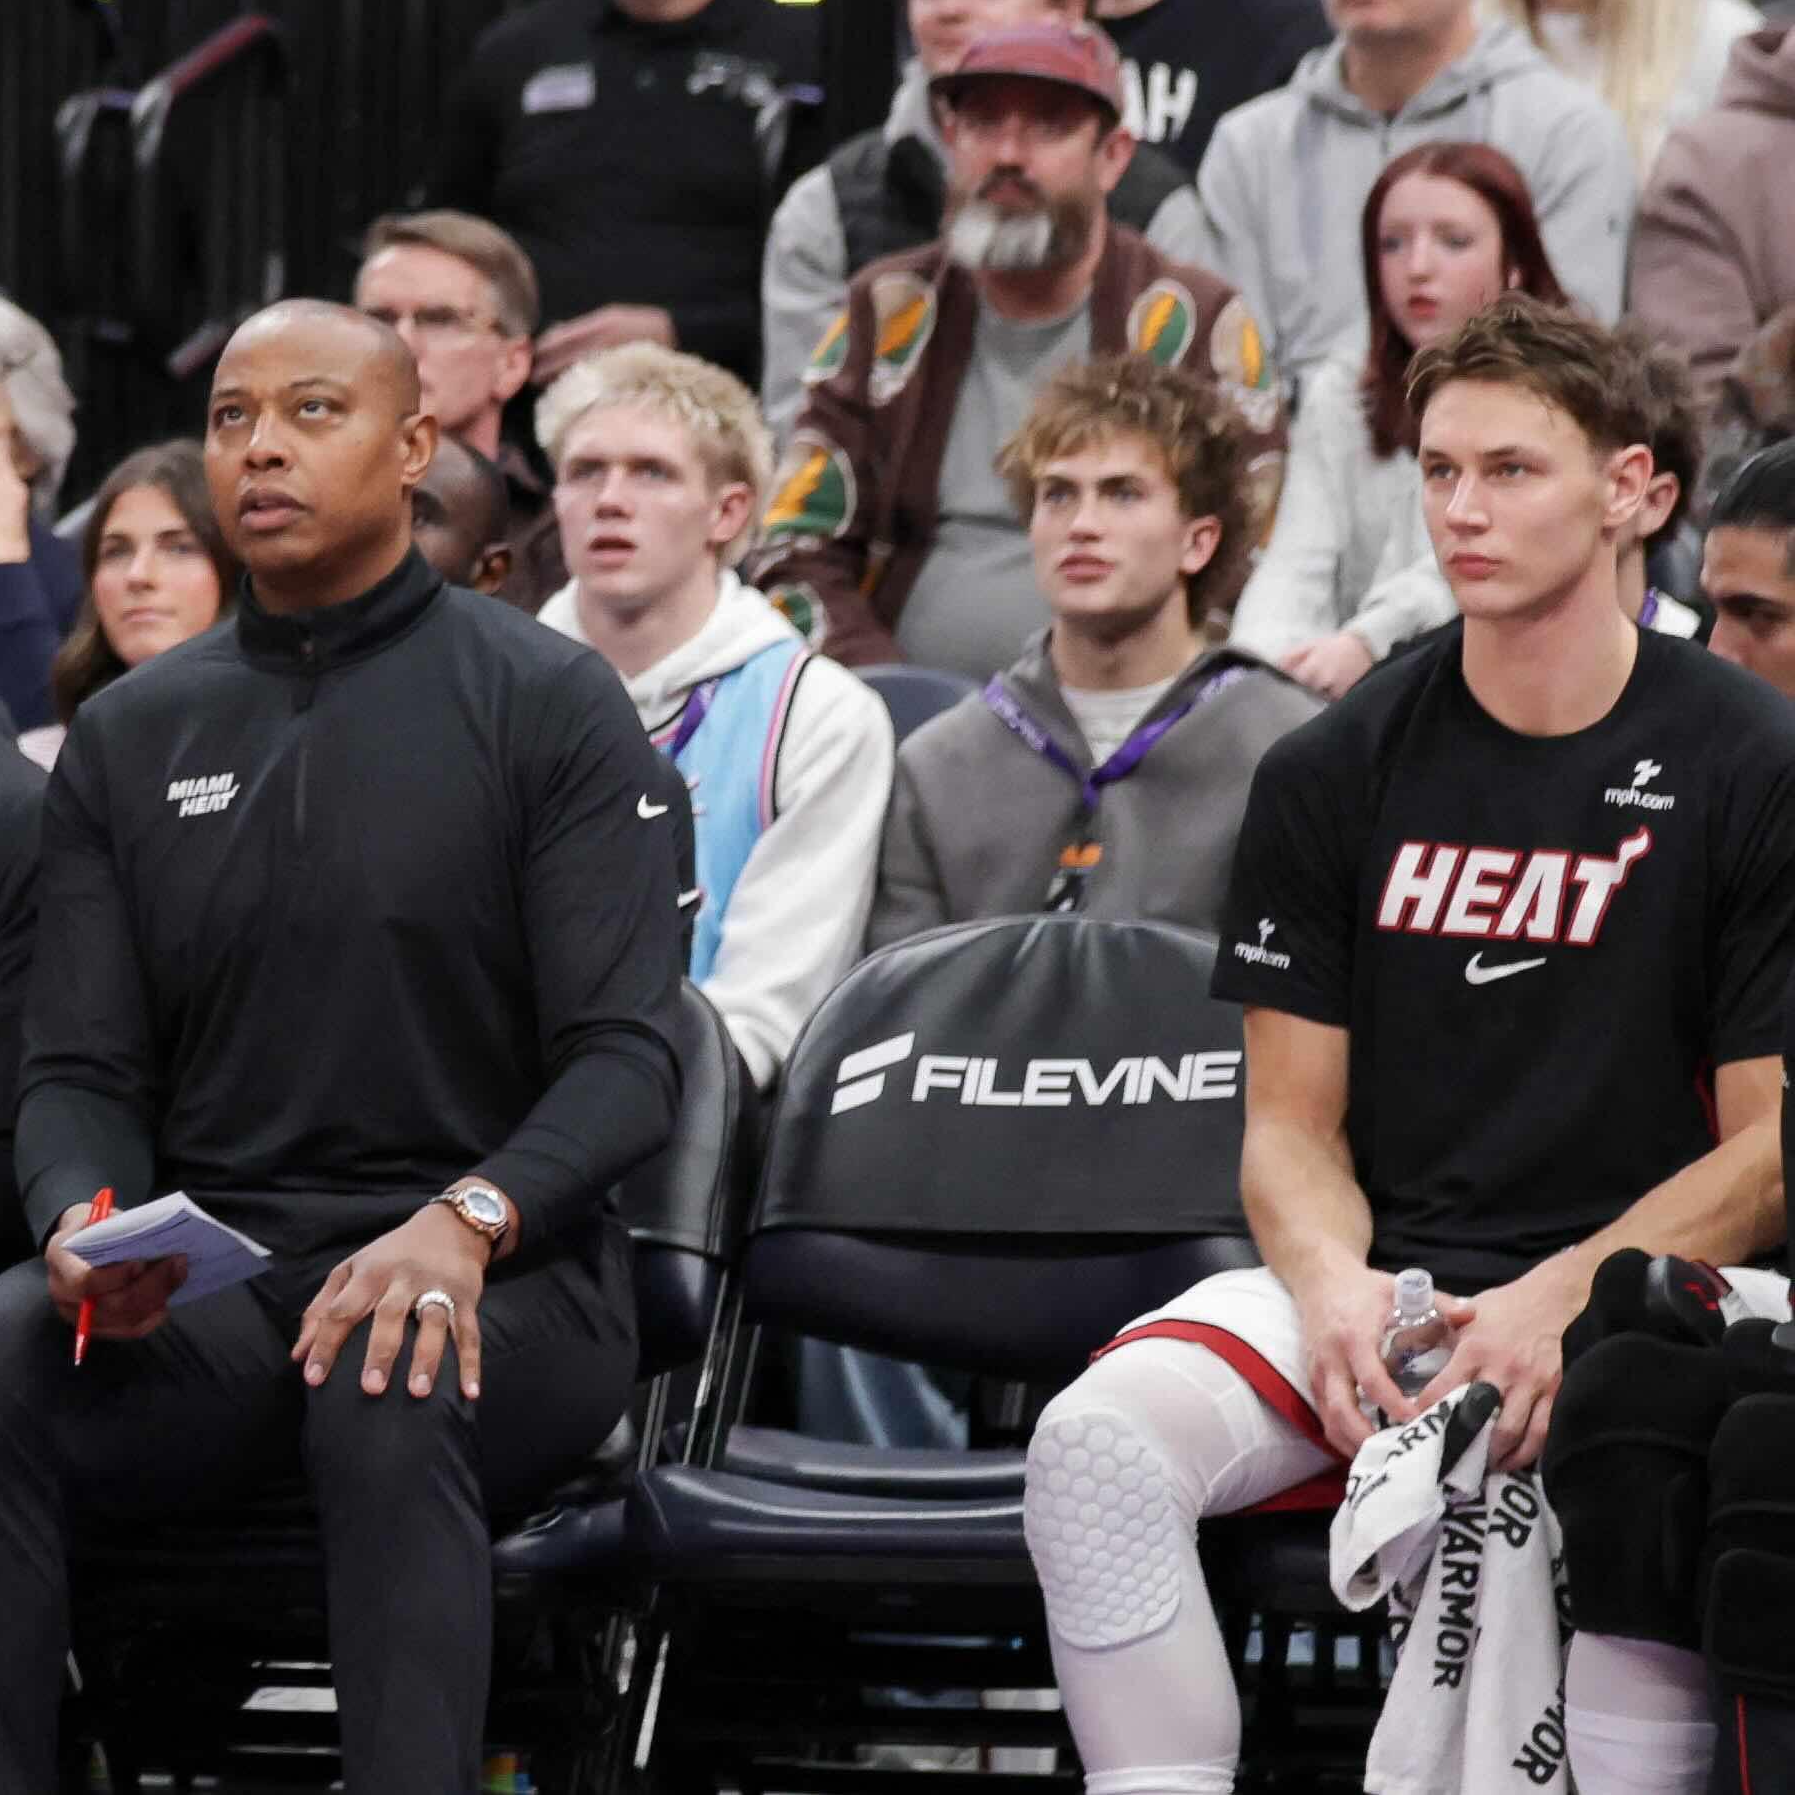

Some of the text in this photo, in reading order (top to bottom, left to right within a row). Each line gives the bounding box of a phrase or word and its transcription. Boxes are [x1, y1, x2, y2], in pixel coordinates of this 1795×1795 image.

[166, 771, 235, 802] MIAMI
[178, 782, 241, 818] HEAT
[1377, 825, 1653, 947] HEAT
[911, 1049, 1243, 1107] FILEVINE
